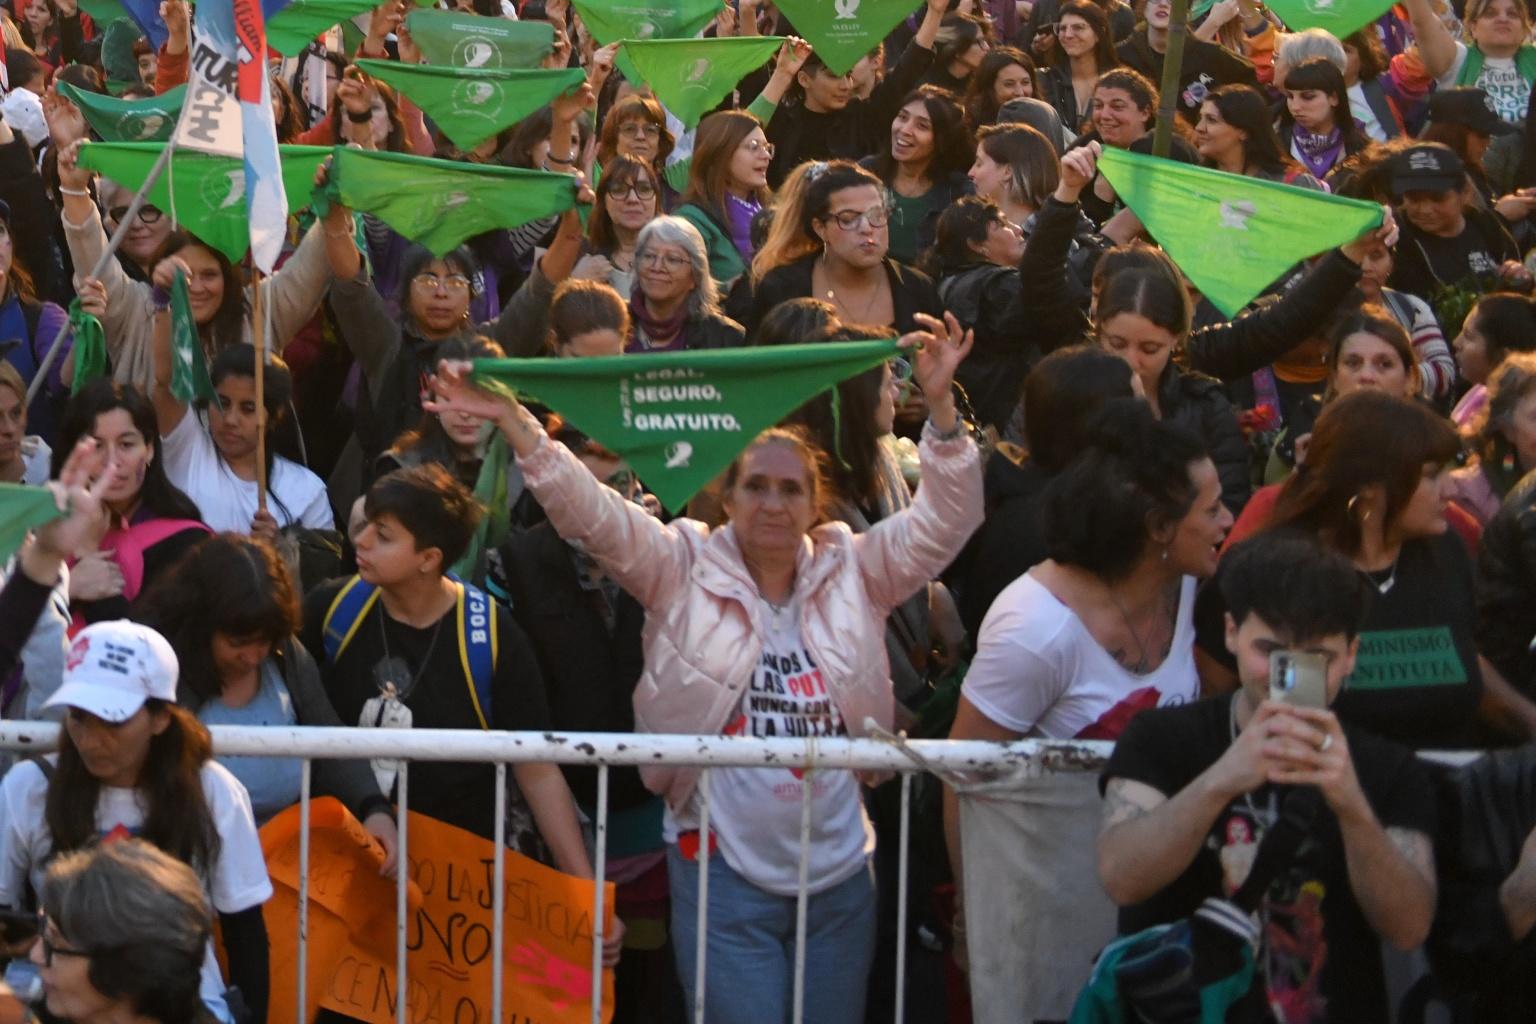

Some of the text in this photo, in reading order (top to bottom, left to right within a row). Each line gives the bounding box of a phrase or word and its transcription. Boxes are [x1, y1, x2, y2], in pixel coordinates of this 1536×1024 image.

[633, 384, 722, 403] SEGURO,
[750, 670, 826, 698] LAS PUT
[750, 696, 799, 714] NUNCA
[751, 716, 777, 739] LA
[447, 862, 475, 902] LA
[478, 858, 594, 946] JSTICIA
[405, 906, 493, 967] NO
